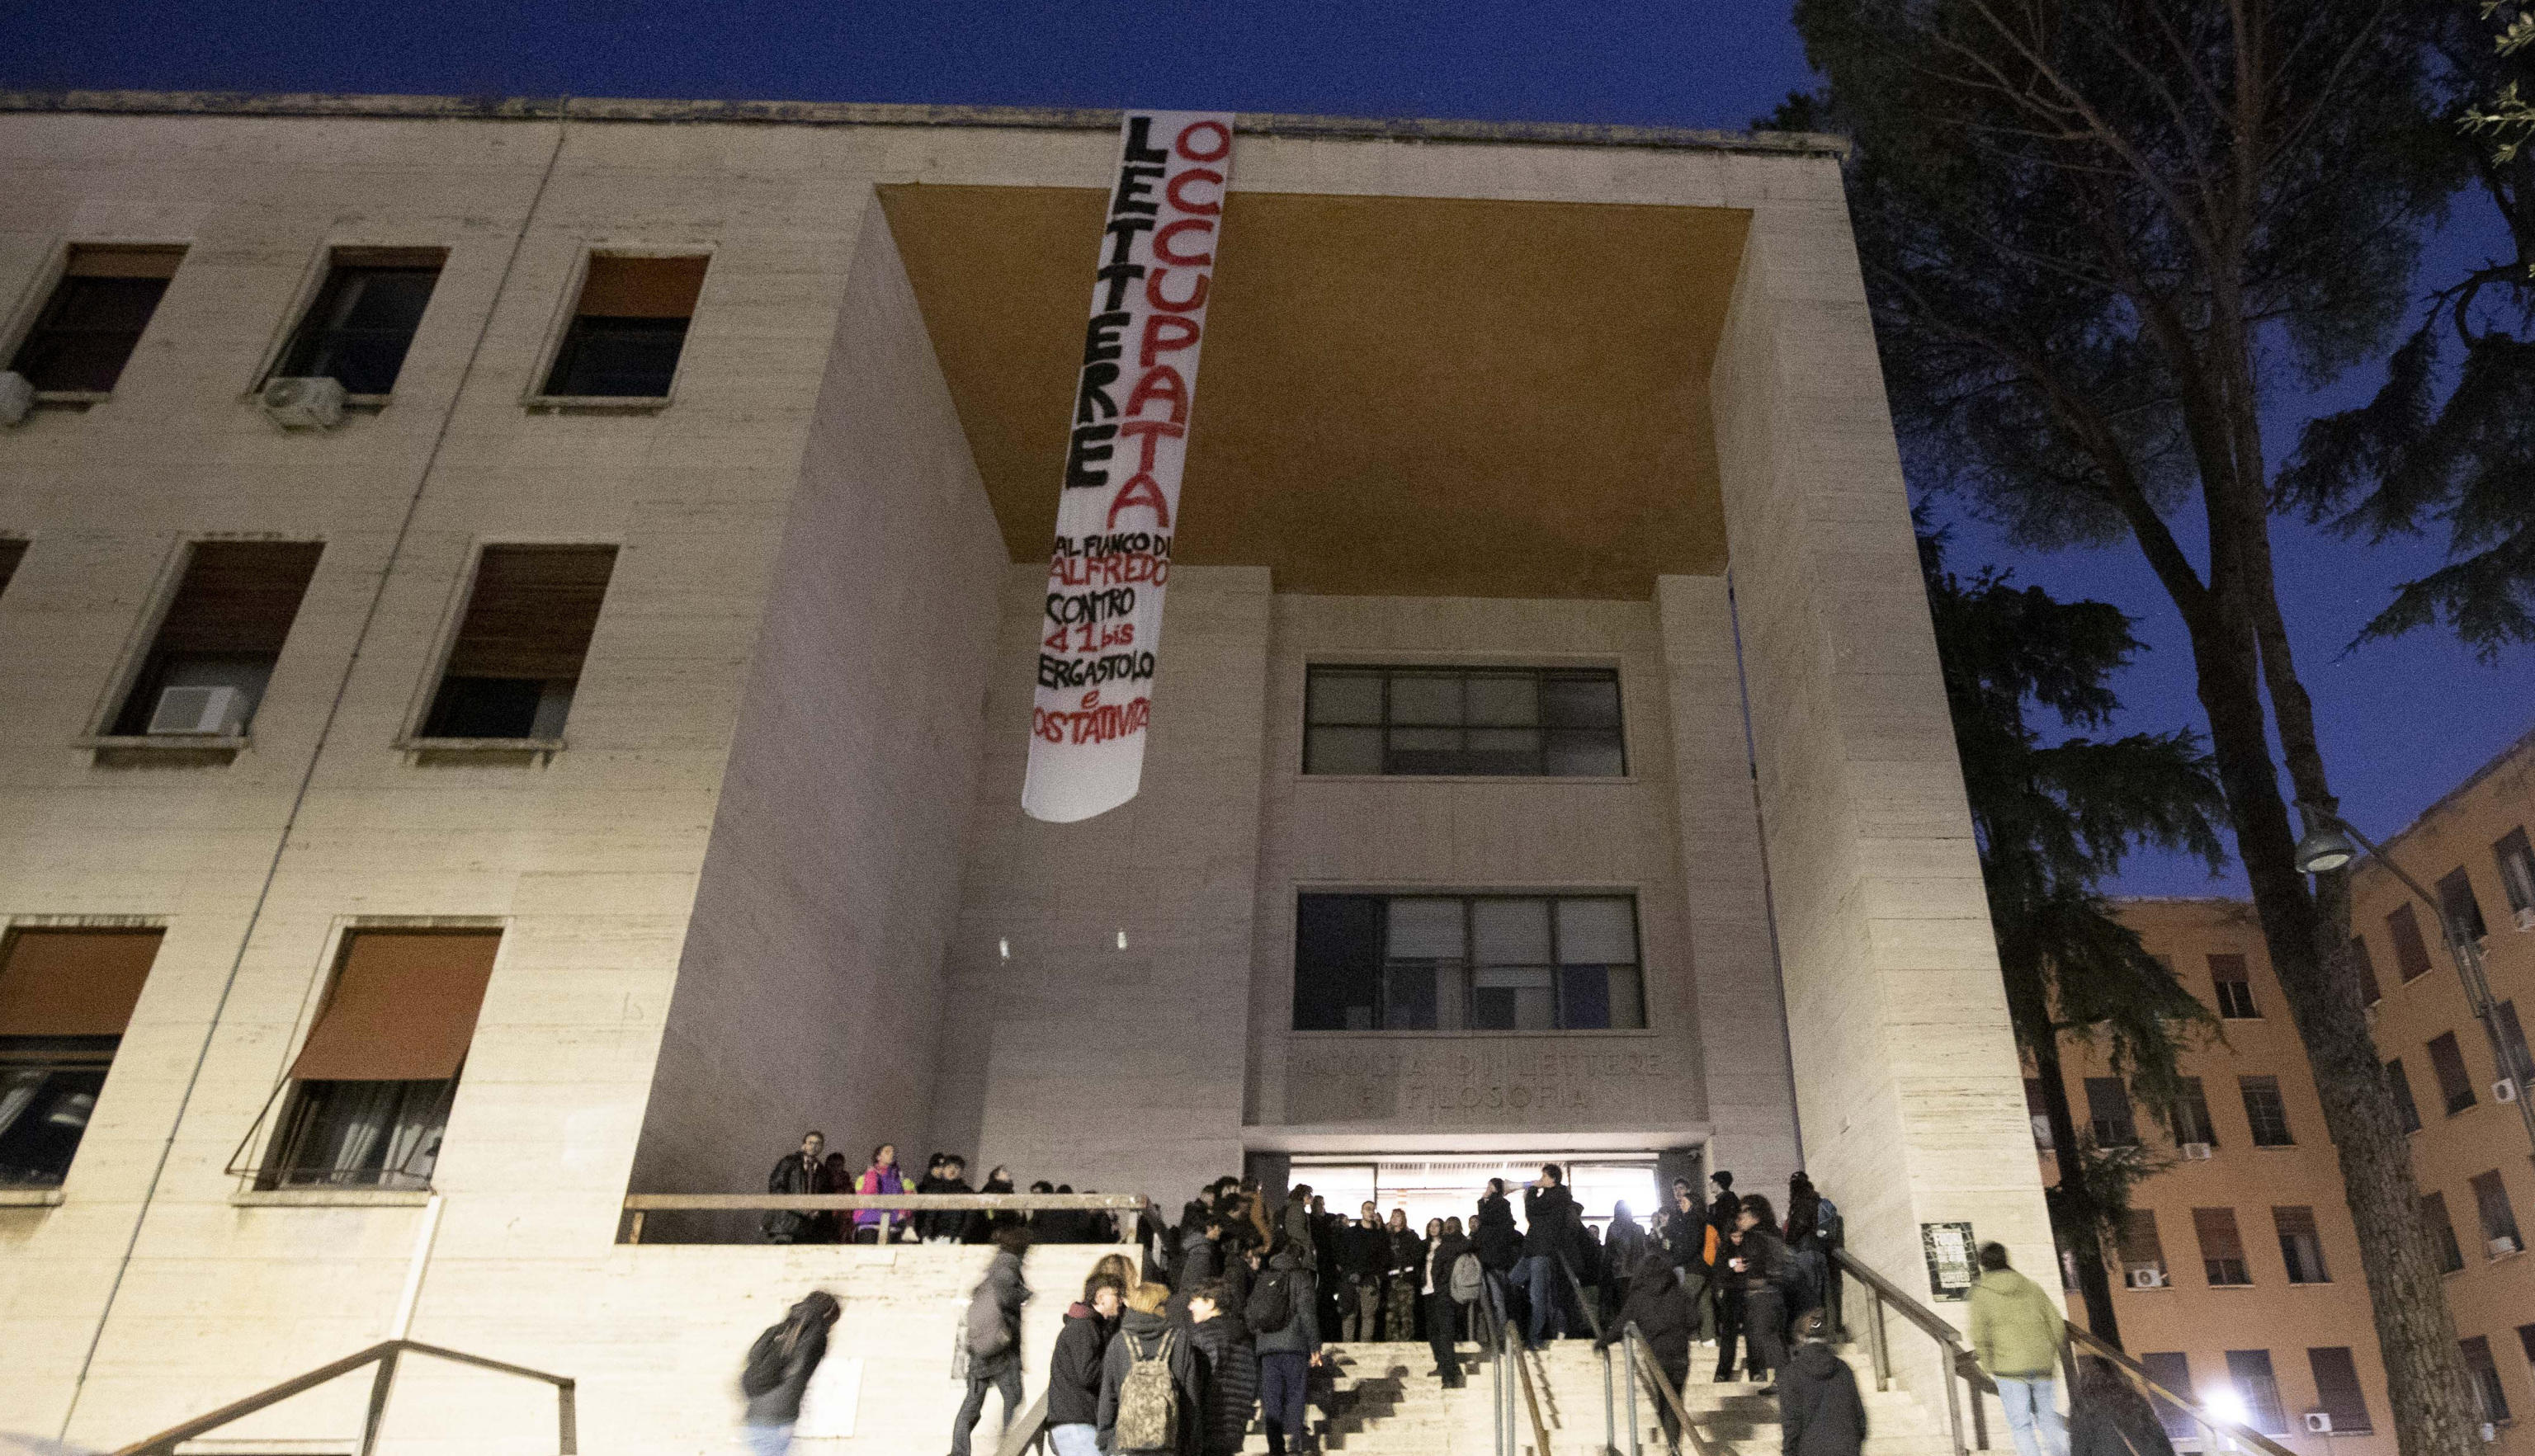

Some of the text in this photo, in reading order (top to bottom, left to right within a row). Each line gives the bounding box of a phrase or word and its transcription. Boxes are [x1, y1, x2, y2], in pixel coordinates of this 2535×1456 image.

[1065, 116, 1168, 489] LETTERE
[1107, 120, 1231, 529] OCCUPATA
[1053, 535, 1081, 558] AL
[1153, 534, 1171, 557] DI
[1050, 553, 1171, 587] ALFREDO
[1046, 587, 1135, 624] CONTRO
[1037, 650, 1154, 690] ERGASTOLO
[1081, 690, 1100, 709] e
[1407, 1084, 1589, 1110] FILOSOFIA
